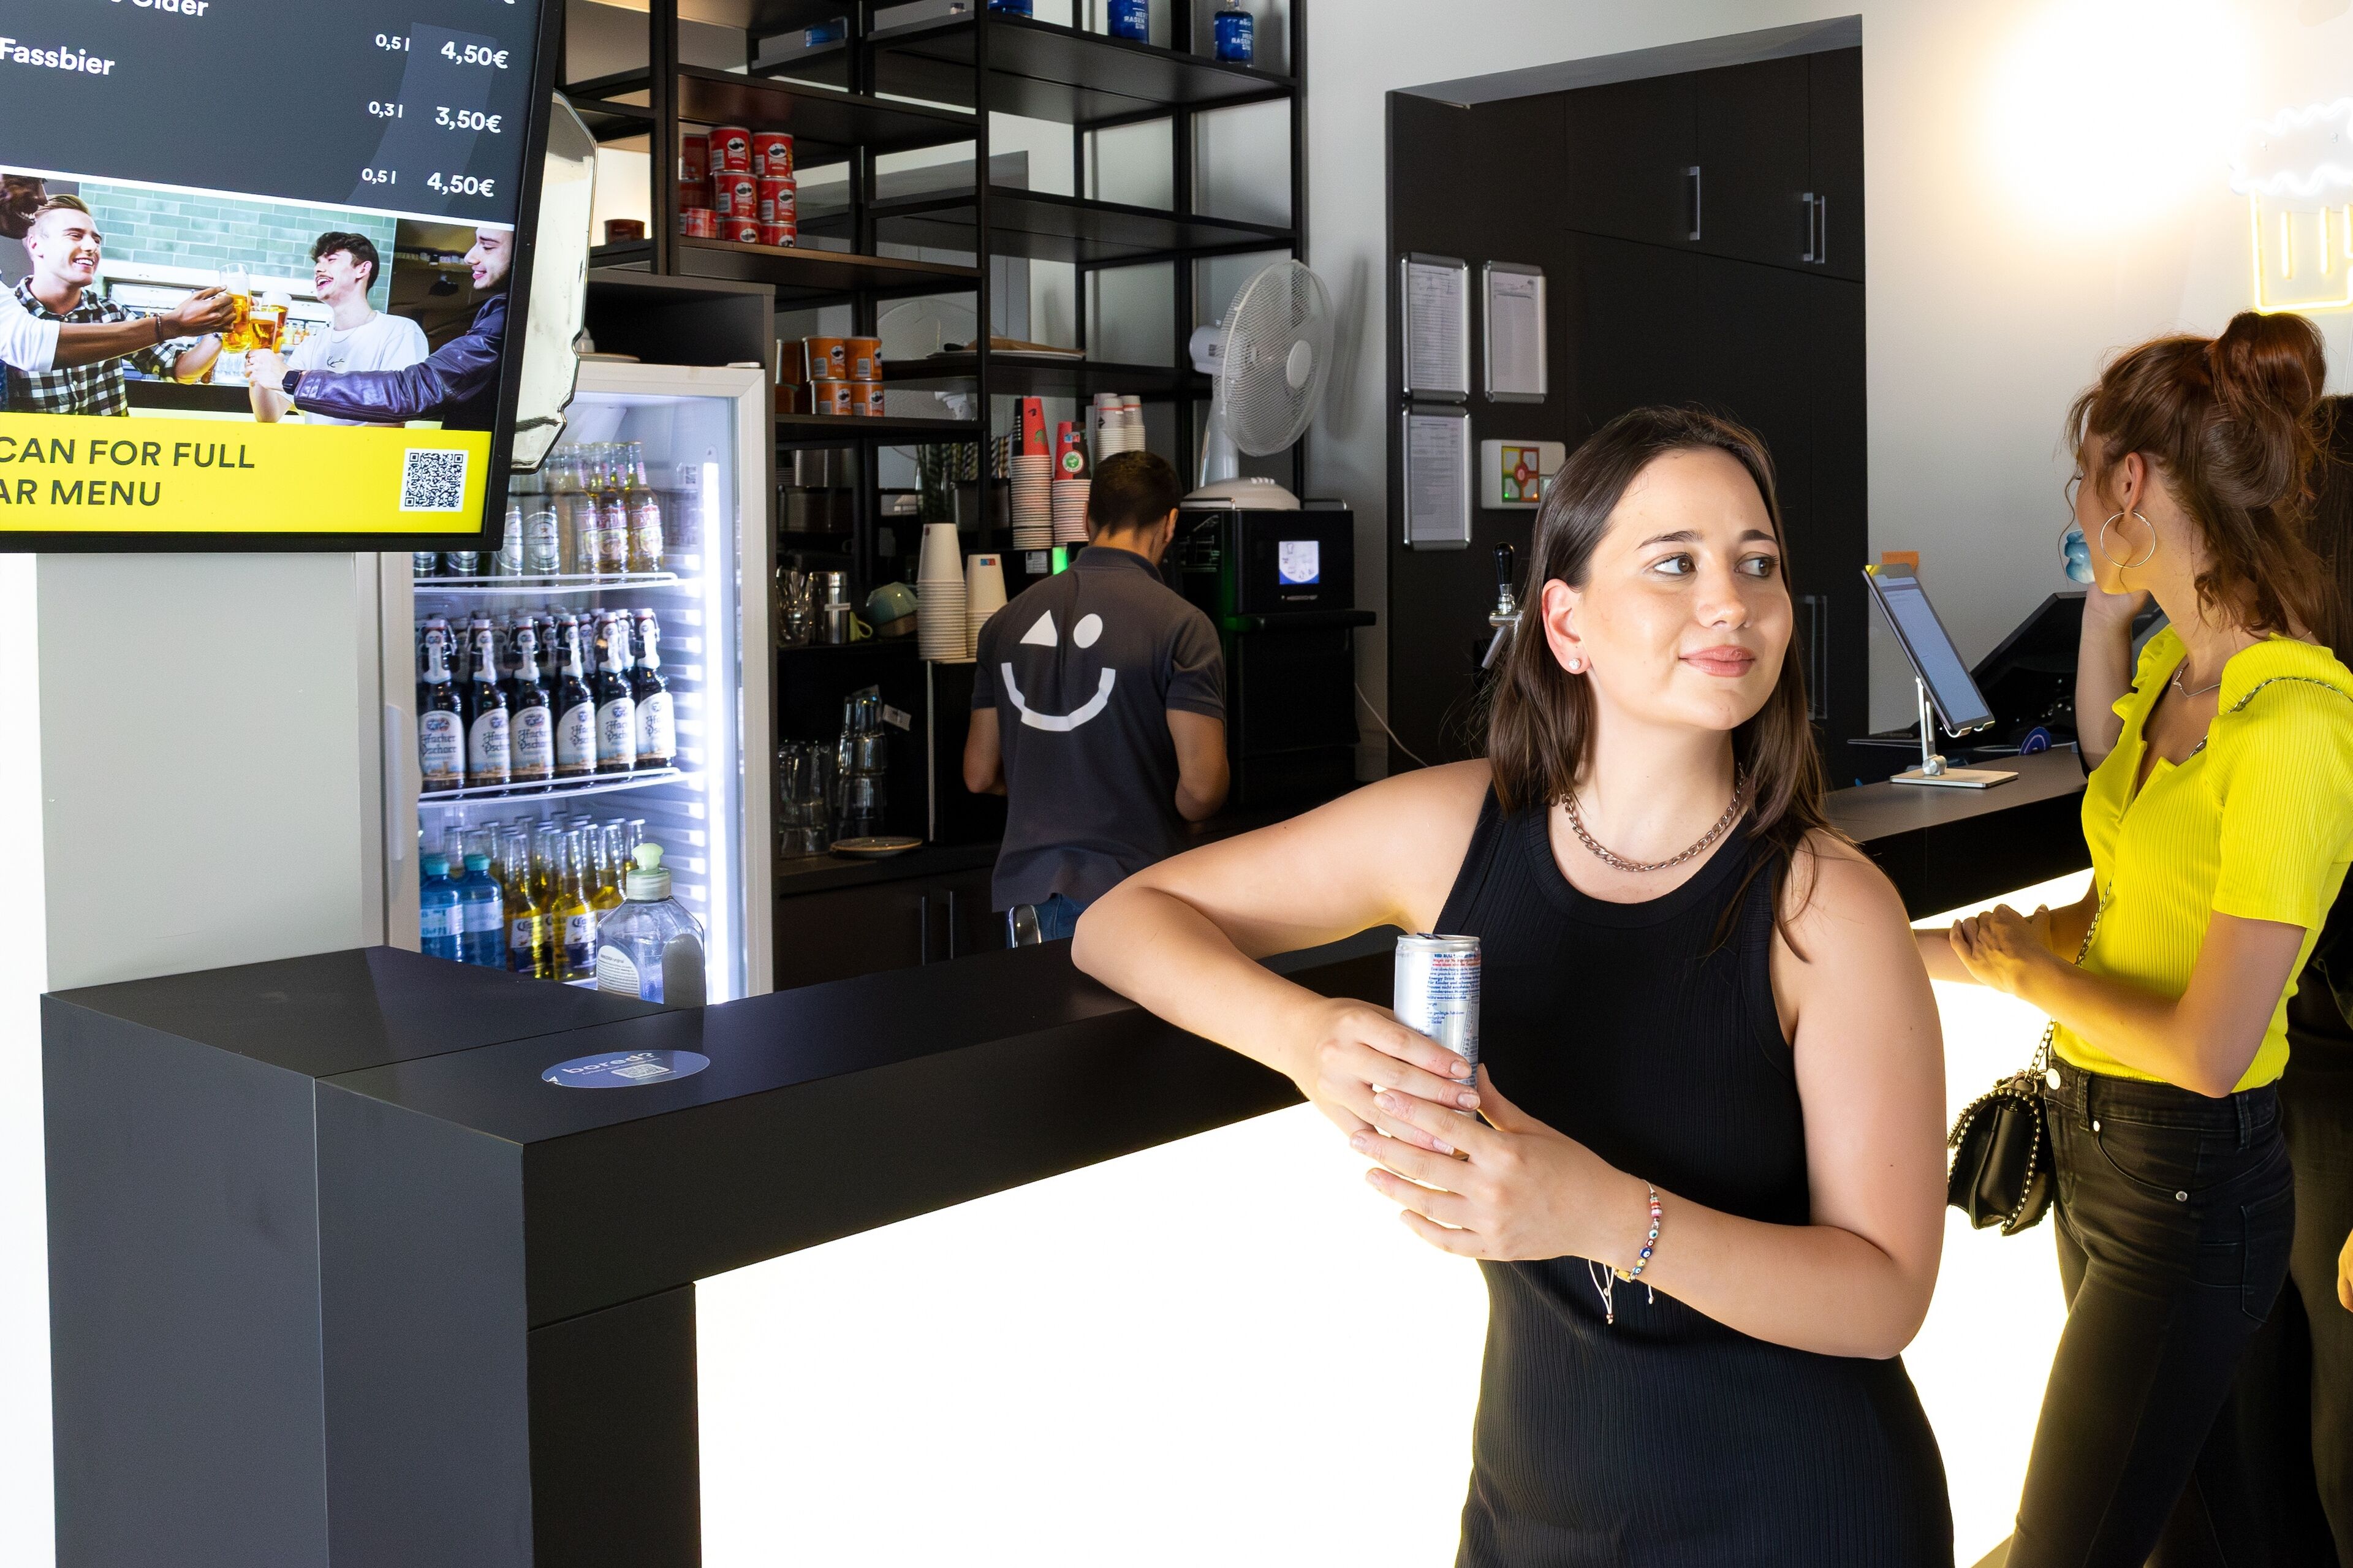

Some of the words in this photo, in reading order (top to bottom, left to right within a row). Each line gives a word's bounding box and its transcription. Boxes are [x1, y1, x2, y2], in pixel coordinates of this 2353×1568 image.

[0, 37, 115, 75] Fassbier
[375, 34, 401, 51] 0,5
[441, 41, 509, 69] 4,50€
[368, 101, 395, 118] 0,3
[435, 106, 502, 134] 3,50€
[362, 168, 388, 184] 0,5
[426, 172, 495, 197] 4,50€
[89, 440, 161, 466] FOR
[173, 442, 255, 468] FULL
[51, 480, 161, 506] MENU
